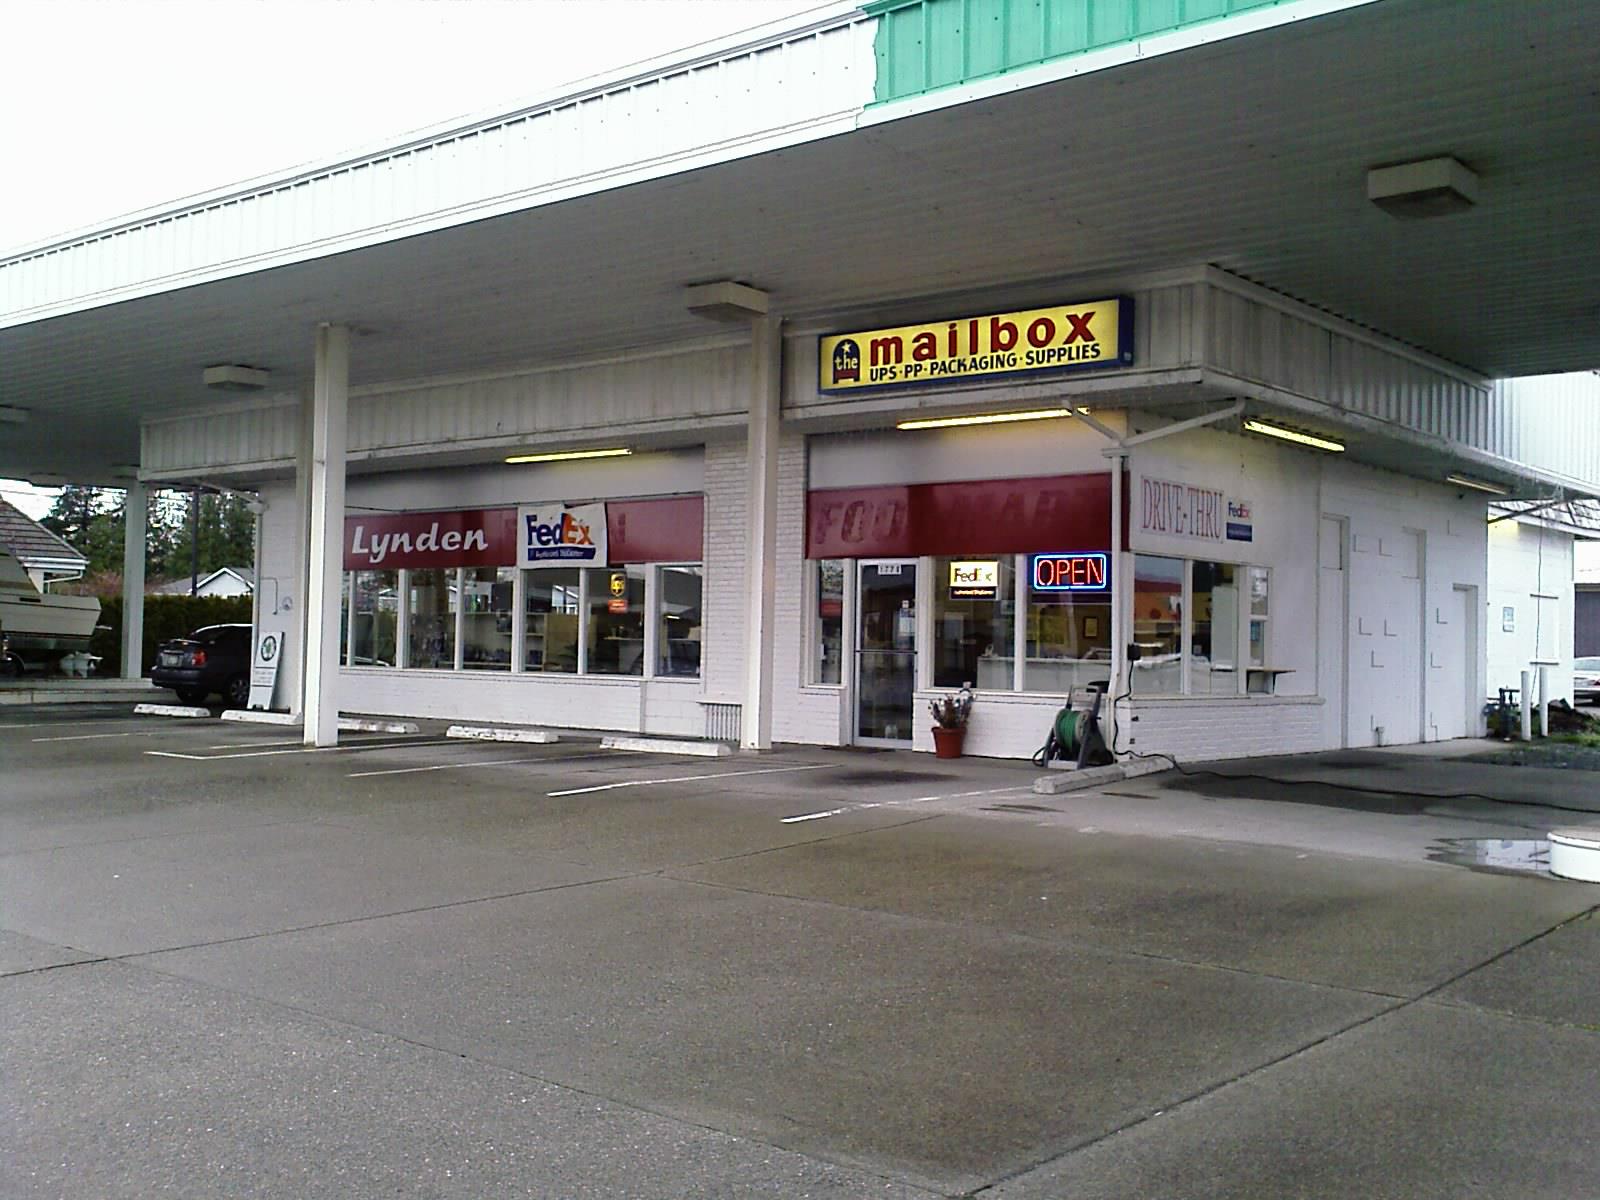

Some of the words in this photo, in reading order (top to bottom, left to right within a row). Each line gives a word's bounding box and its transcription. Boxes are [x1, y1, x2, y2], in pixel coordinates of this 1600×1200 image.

[835, 353, 859, 370] the
[870, 312, 1097, 367] mailbox
[351, 522, 489, 563] Lynden
[526, 512, 595, 546] FedEx
[1037, 558, 1103, 586] OPEN
